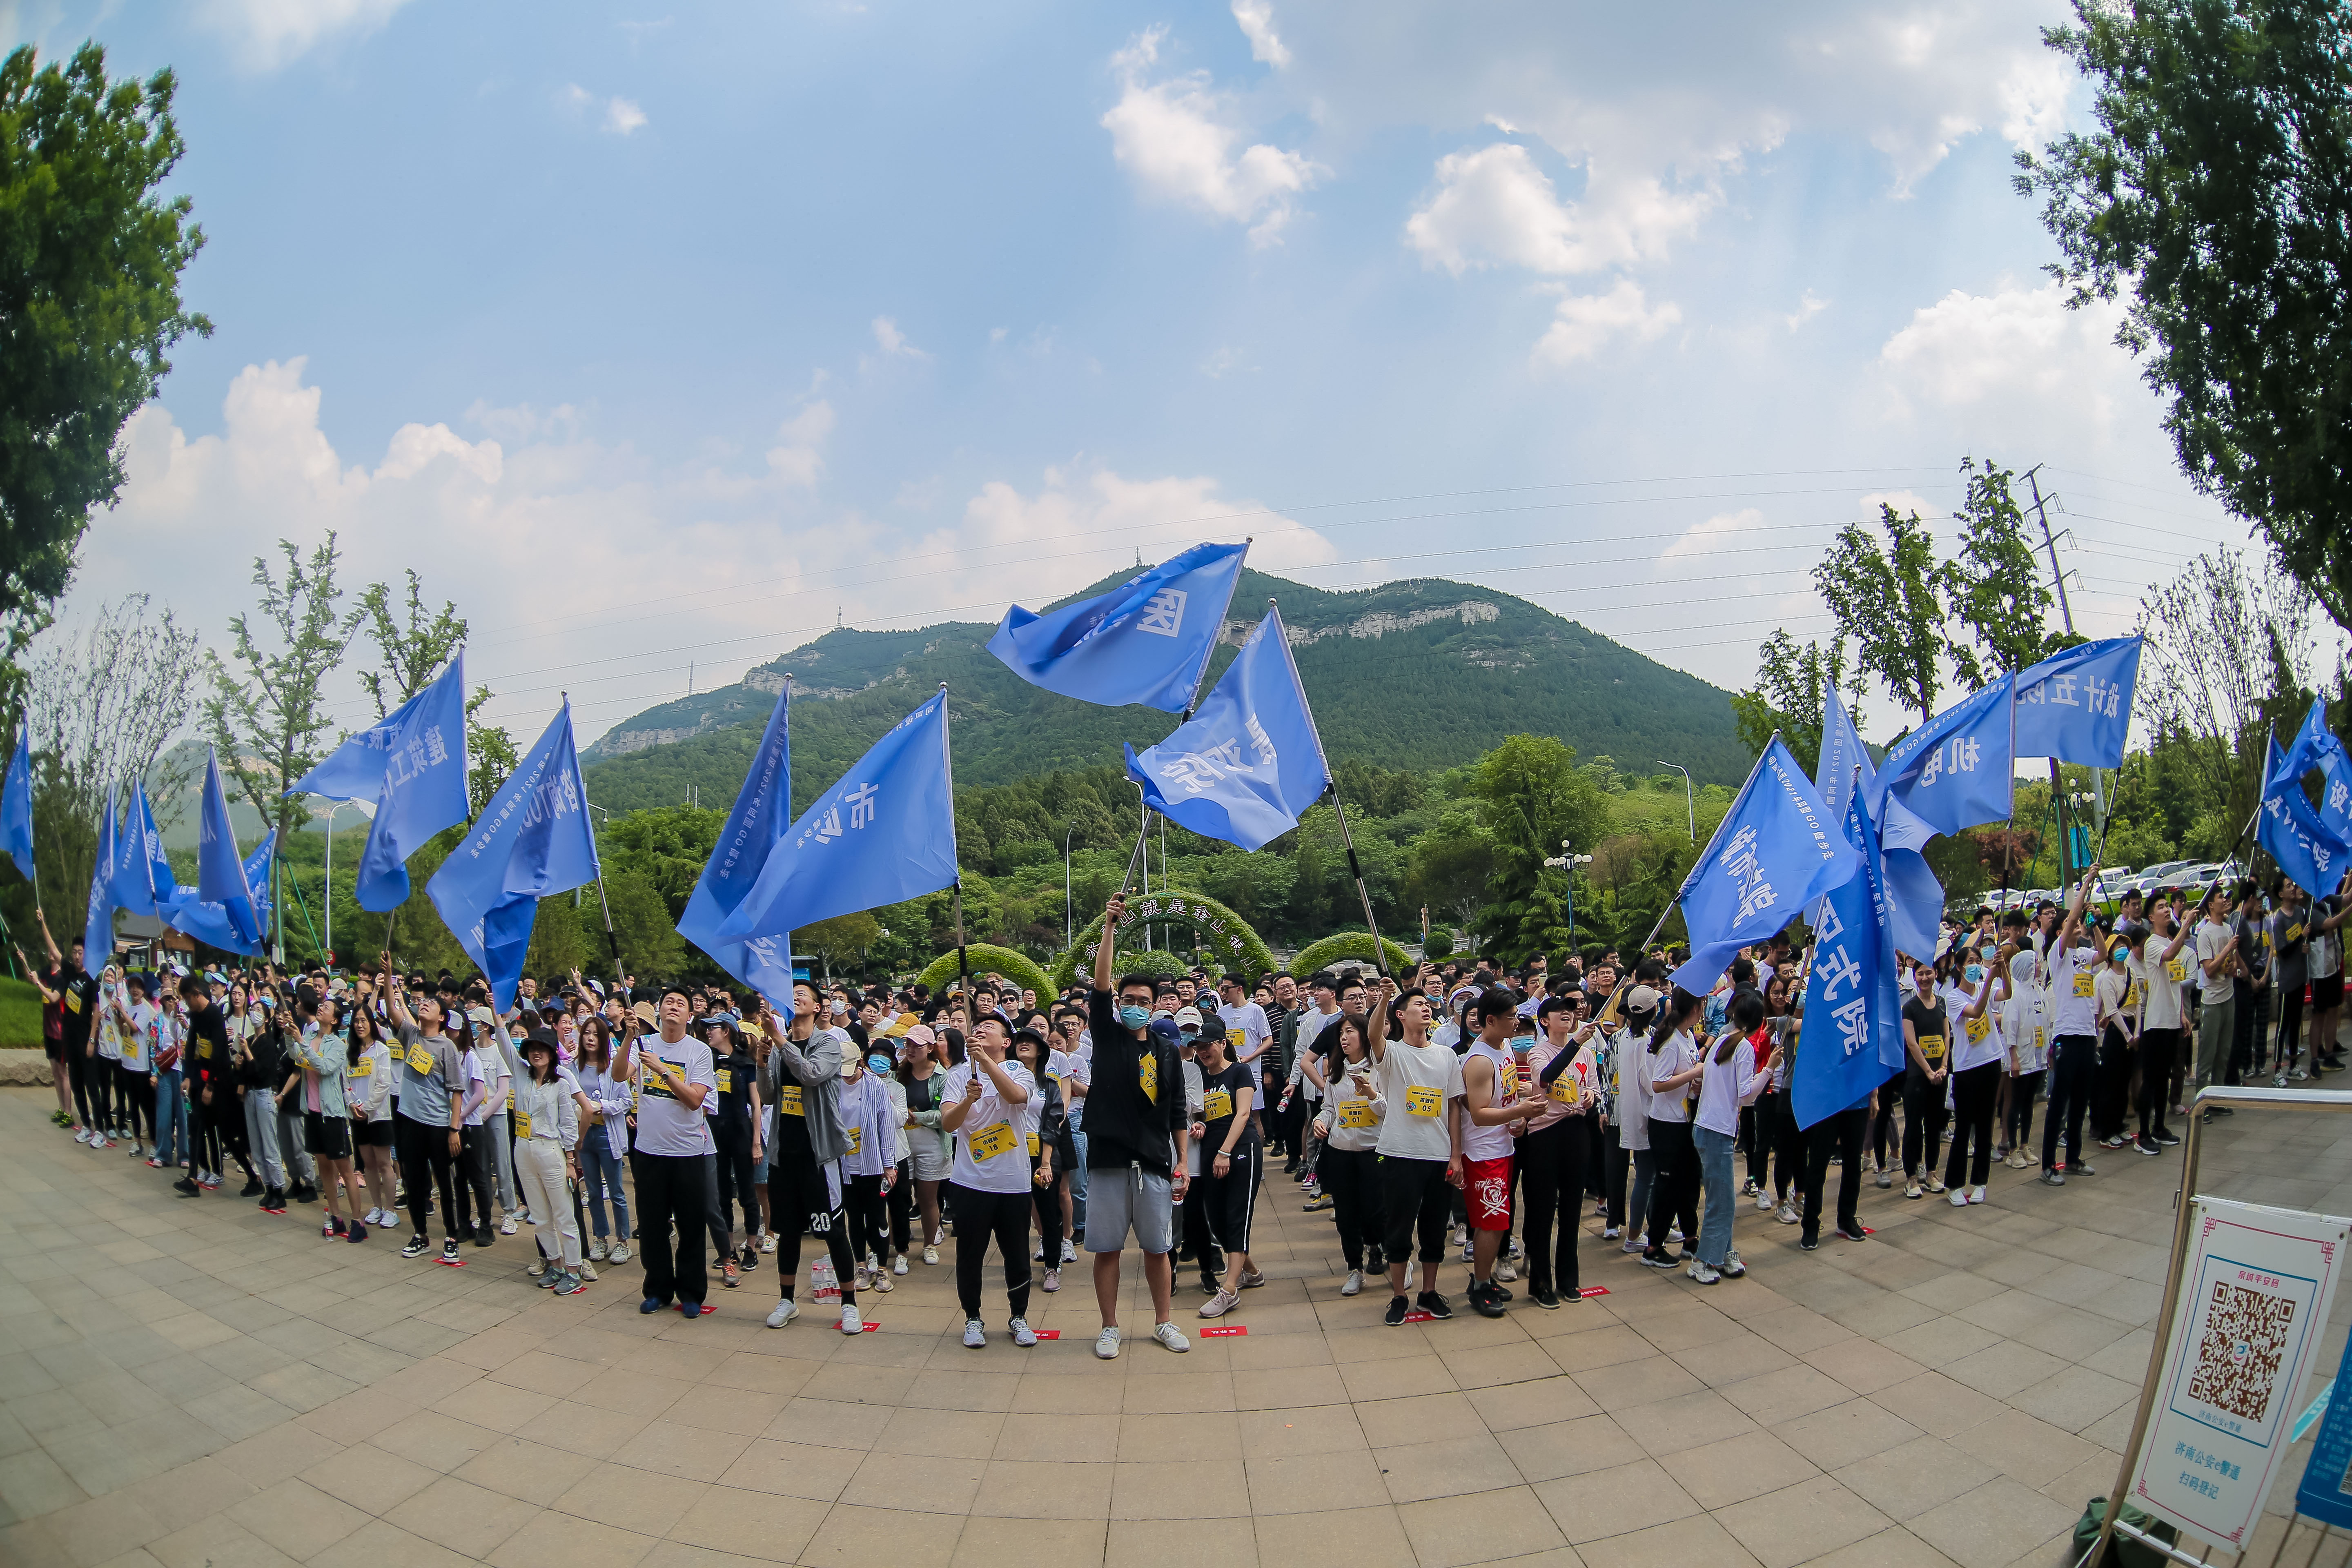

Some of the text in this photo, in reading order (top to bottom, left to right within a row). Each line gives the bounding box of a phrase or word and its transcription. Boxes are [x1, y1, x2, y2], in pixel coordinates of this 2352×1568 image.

[1074, 898, 1256, 978] 绿水山就是金山银山
[1145, 1080, 1153, 1088] 17
[811, 1213, 831, 1231] 20
[2238, 1270, 2280, 1288] 泉城平安码
[2199, 1409, 2243, 1433] 济南公安e警通
[2175, 1440, 2242, 1481] 济南公安e警通
[2178, 1470, 2220, 1500] 扫码登记
